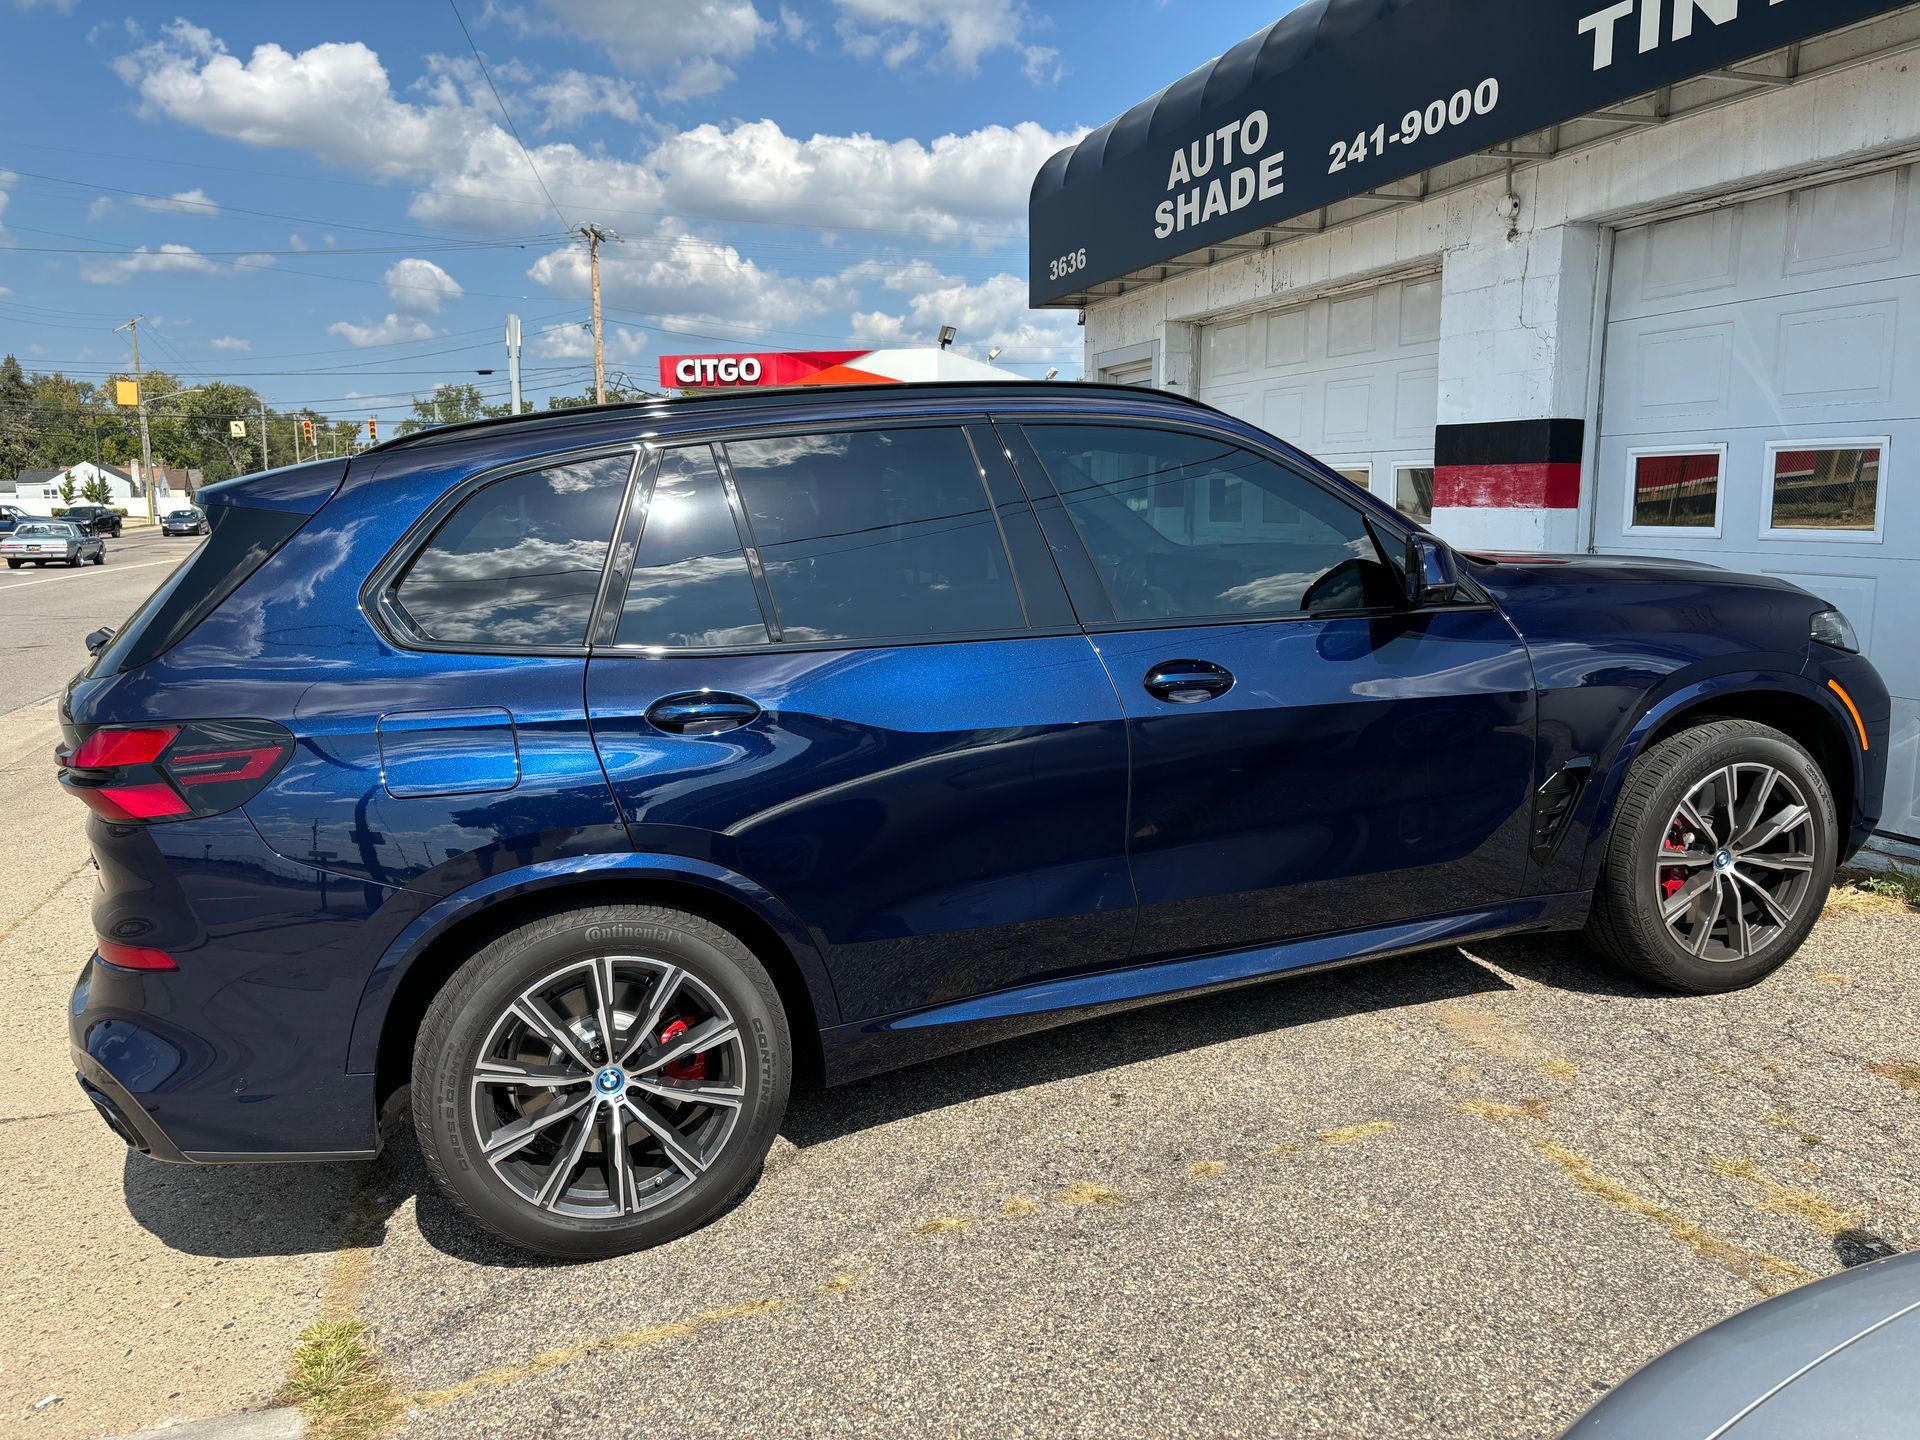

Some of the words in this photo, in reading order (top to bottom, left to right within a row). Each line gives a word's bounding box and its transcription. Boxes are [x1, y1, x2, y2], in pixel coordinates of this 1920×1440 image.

[1578, 0, 1785, 71] TIN
[1167, 109, 1268, 191] AUTO
[1328, 77, 1498, 174] 241-9000
[1154, 151, 1284, 239] SHADE
[1050, 248, 1086, 280] 3636
[676, 358, 761, 382] CITGO
[585, 924, 673, 943] Continental
